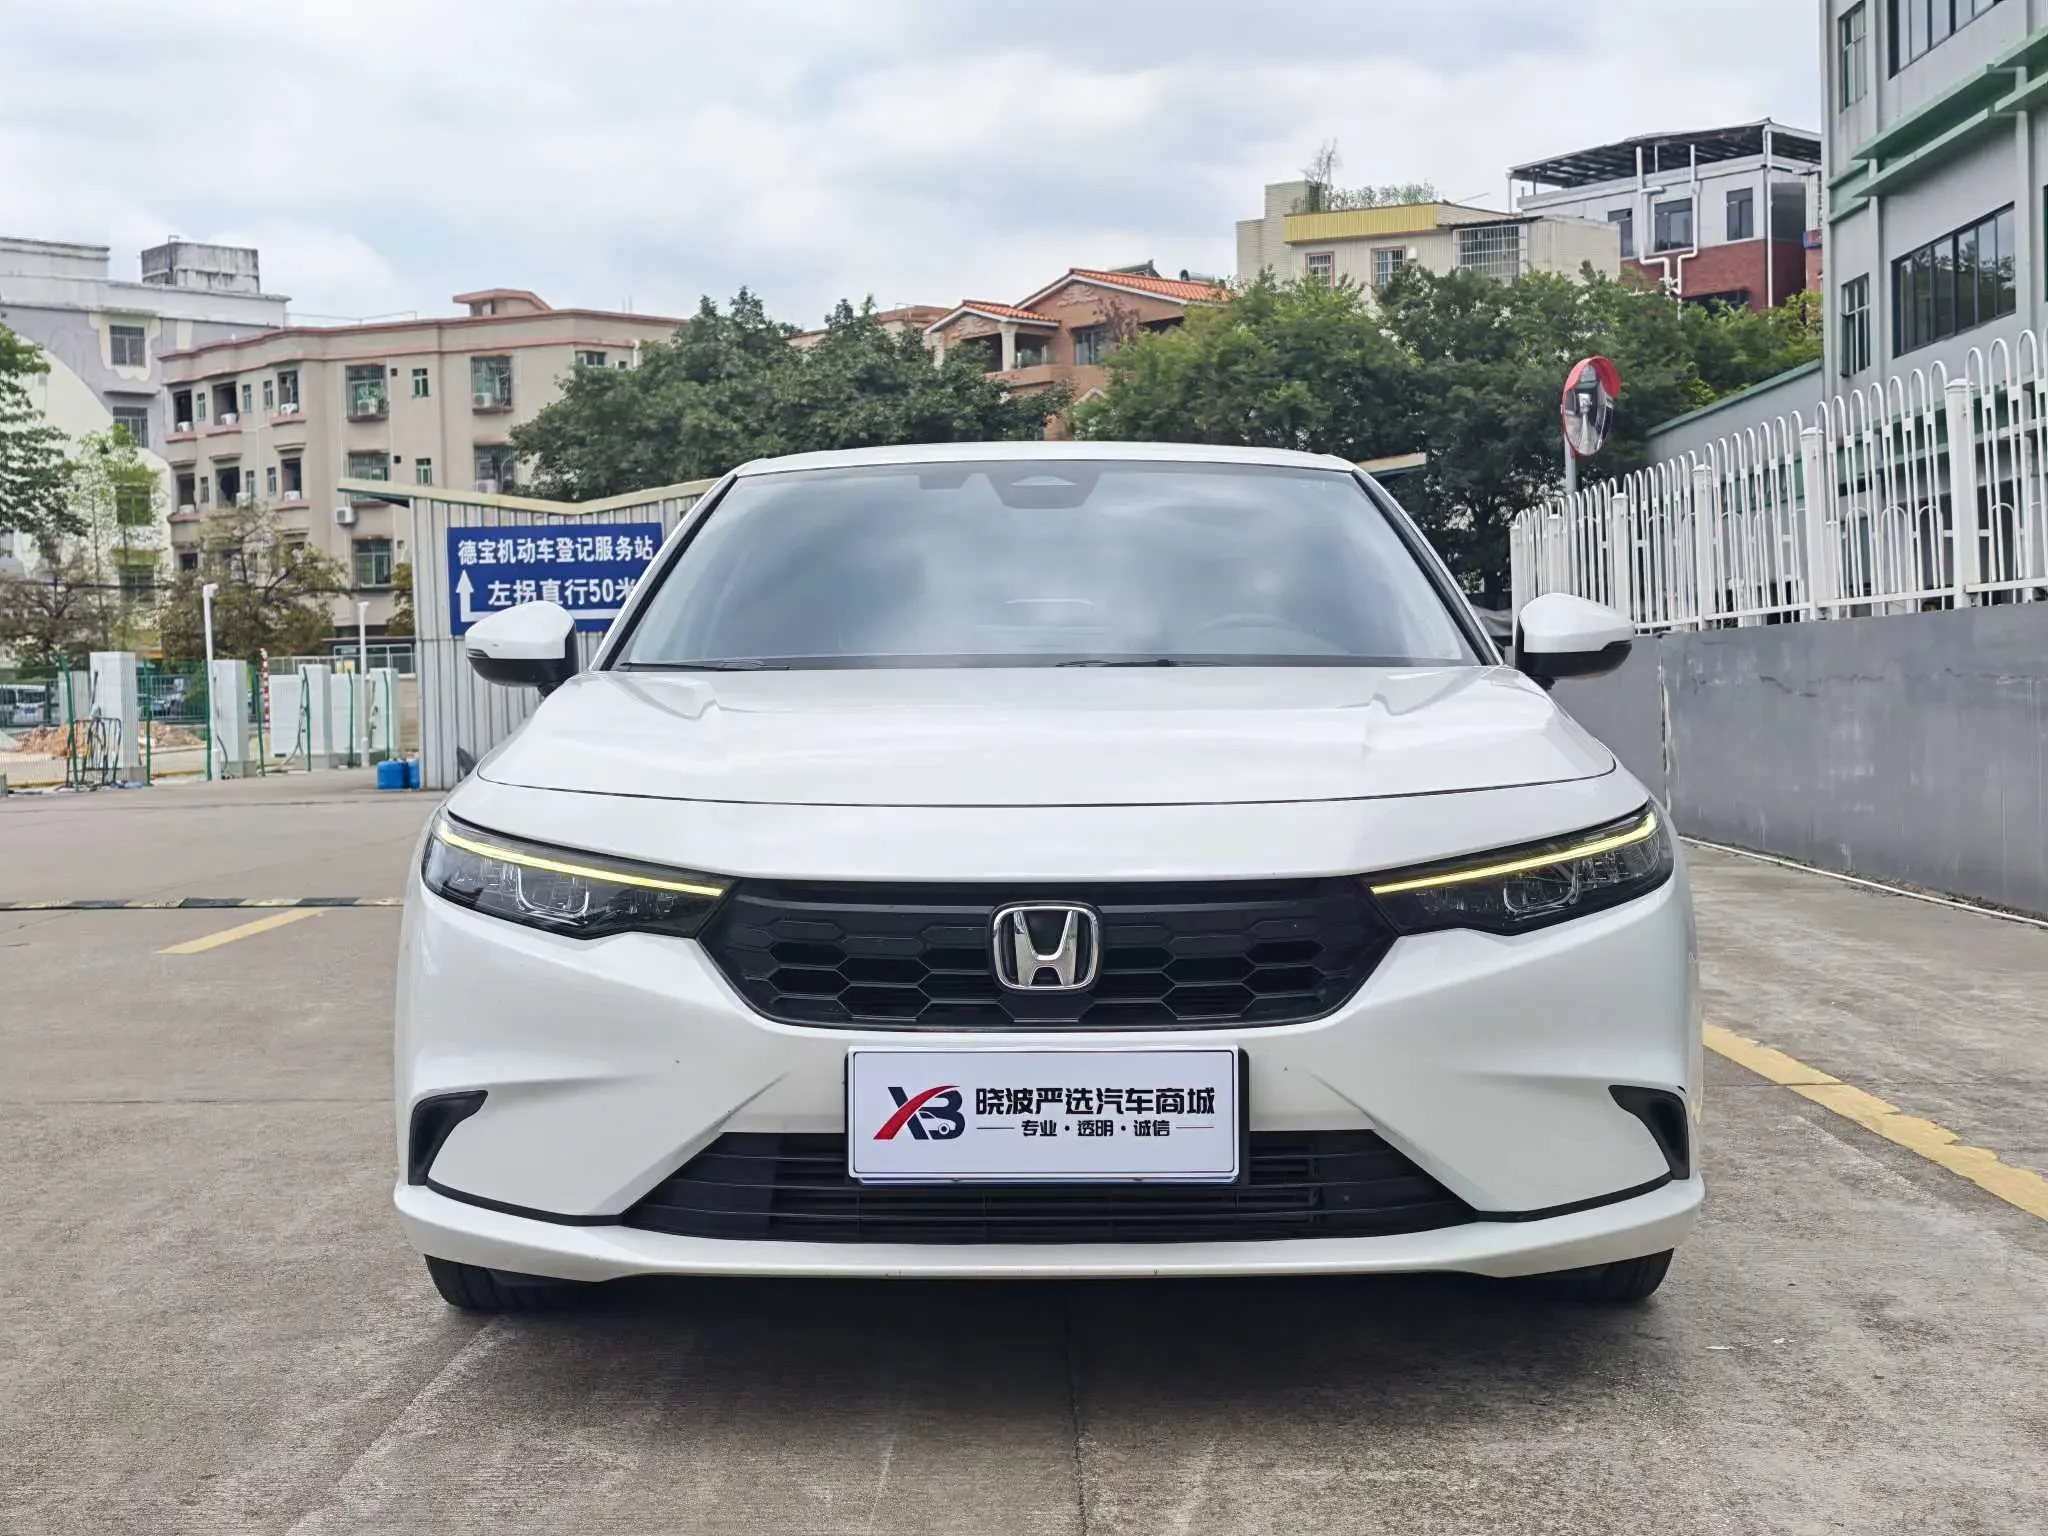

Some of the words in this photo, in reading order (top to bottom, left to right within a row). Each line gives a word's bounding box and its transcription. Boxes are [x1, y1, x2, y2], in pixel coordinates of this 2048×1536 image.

[458, 536, 653, 565] 德宝机动车登记服务站
[975, 1087, 1215, 1115] 晓波严选汽车商城
